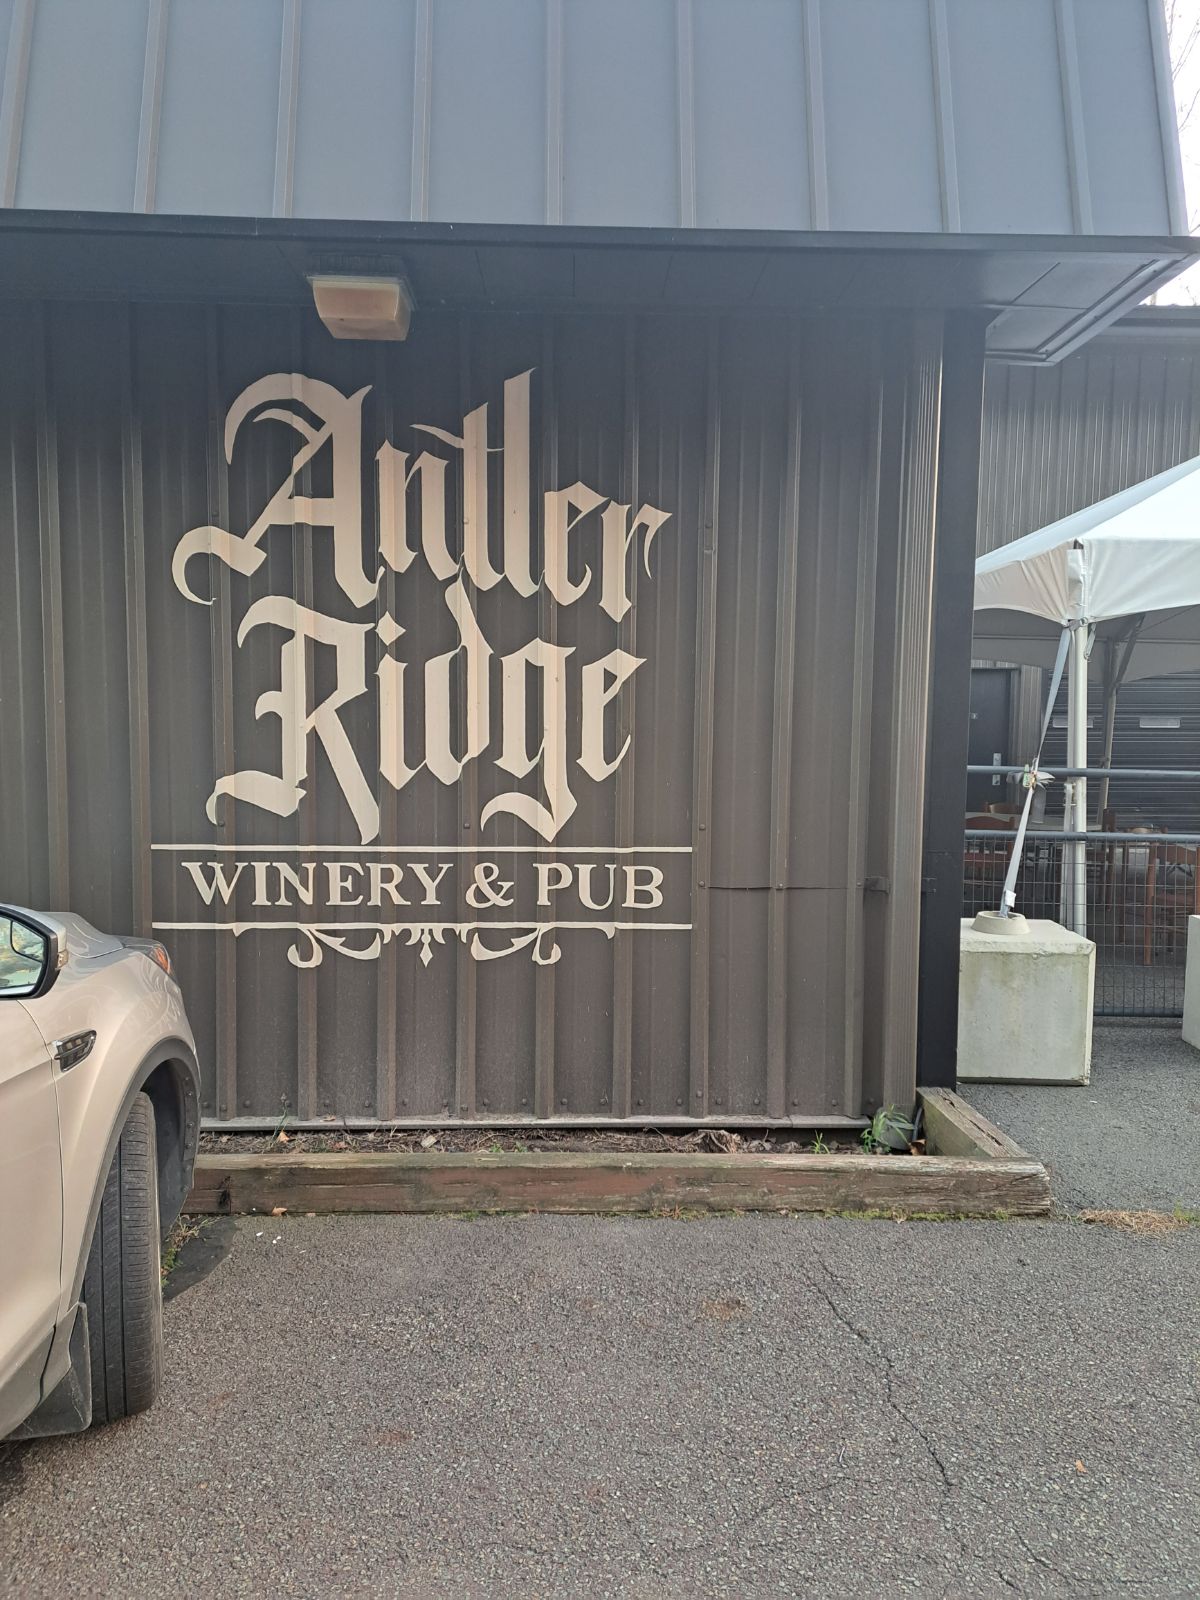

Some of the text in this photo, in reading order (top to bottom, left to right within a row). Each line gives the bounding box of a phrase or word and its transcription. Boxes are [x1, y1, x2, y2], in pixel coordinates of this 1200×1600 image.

[172, 367, 672, 622] Antler
[206, 568, 647, 844] Ridge
[181, 861, 665, 911] WINERY & PUB
